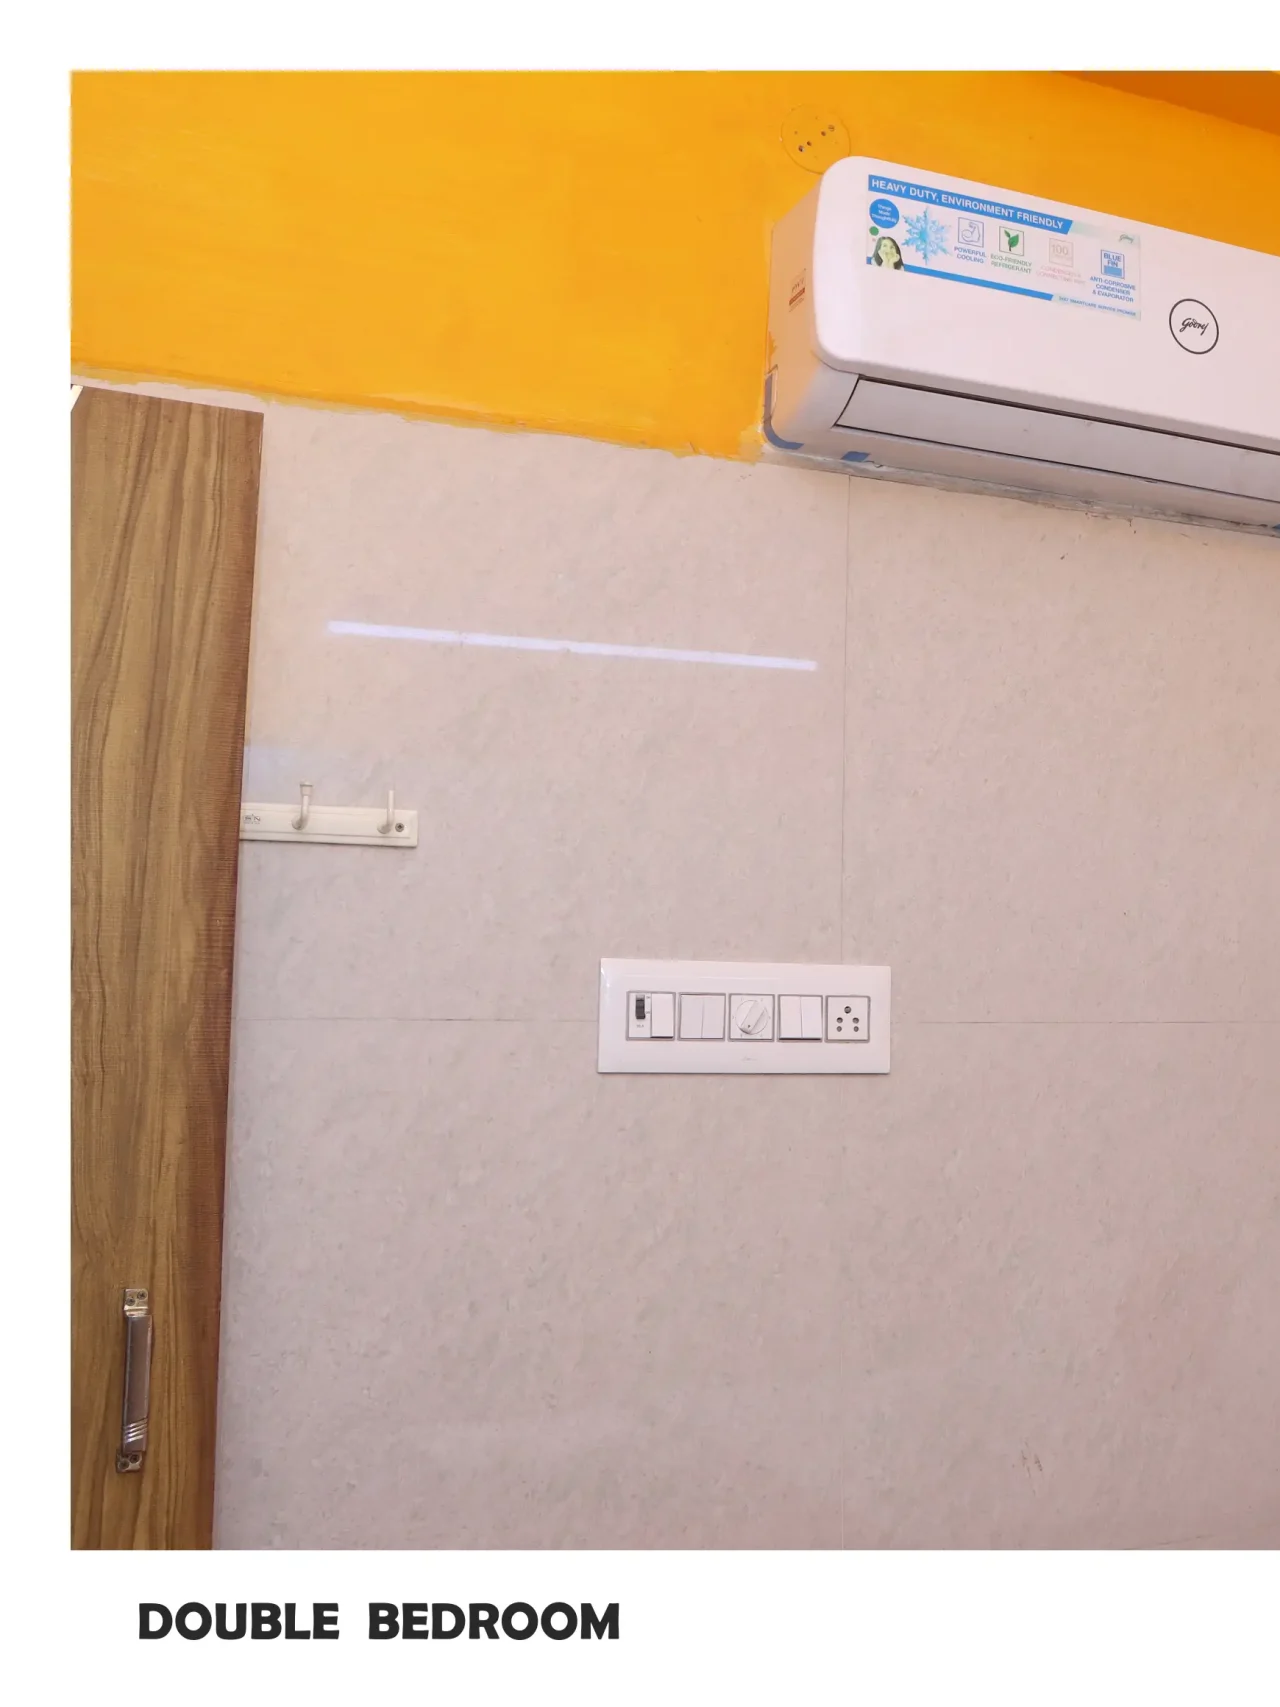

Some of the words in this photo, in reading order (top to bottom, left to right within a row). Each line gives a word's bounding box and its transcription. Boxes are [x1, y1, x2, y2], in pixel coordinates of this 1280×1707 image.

[871, 179, 907, 194] HEAVY
[909, 187, 939, 203] DUTY,
[941, 194, 1014, 218] ENVIRONMENT
[1016, 211, 1064, 230] FRIENDLY
[953, 246, 987, 259] POWERFUL
[956, 253, 985, 265] COOLING
[1103, 252, 1122, 263] BLUE
[990, 253, 1033, 268] ECO-FRIENDLY
[1107, 259, 1119, 268] FIN
[990, 260, 1032, 275] REFRIGERANT
